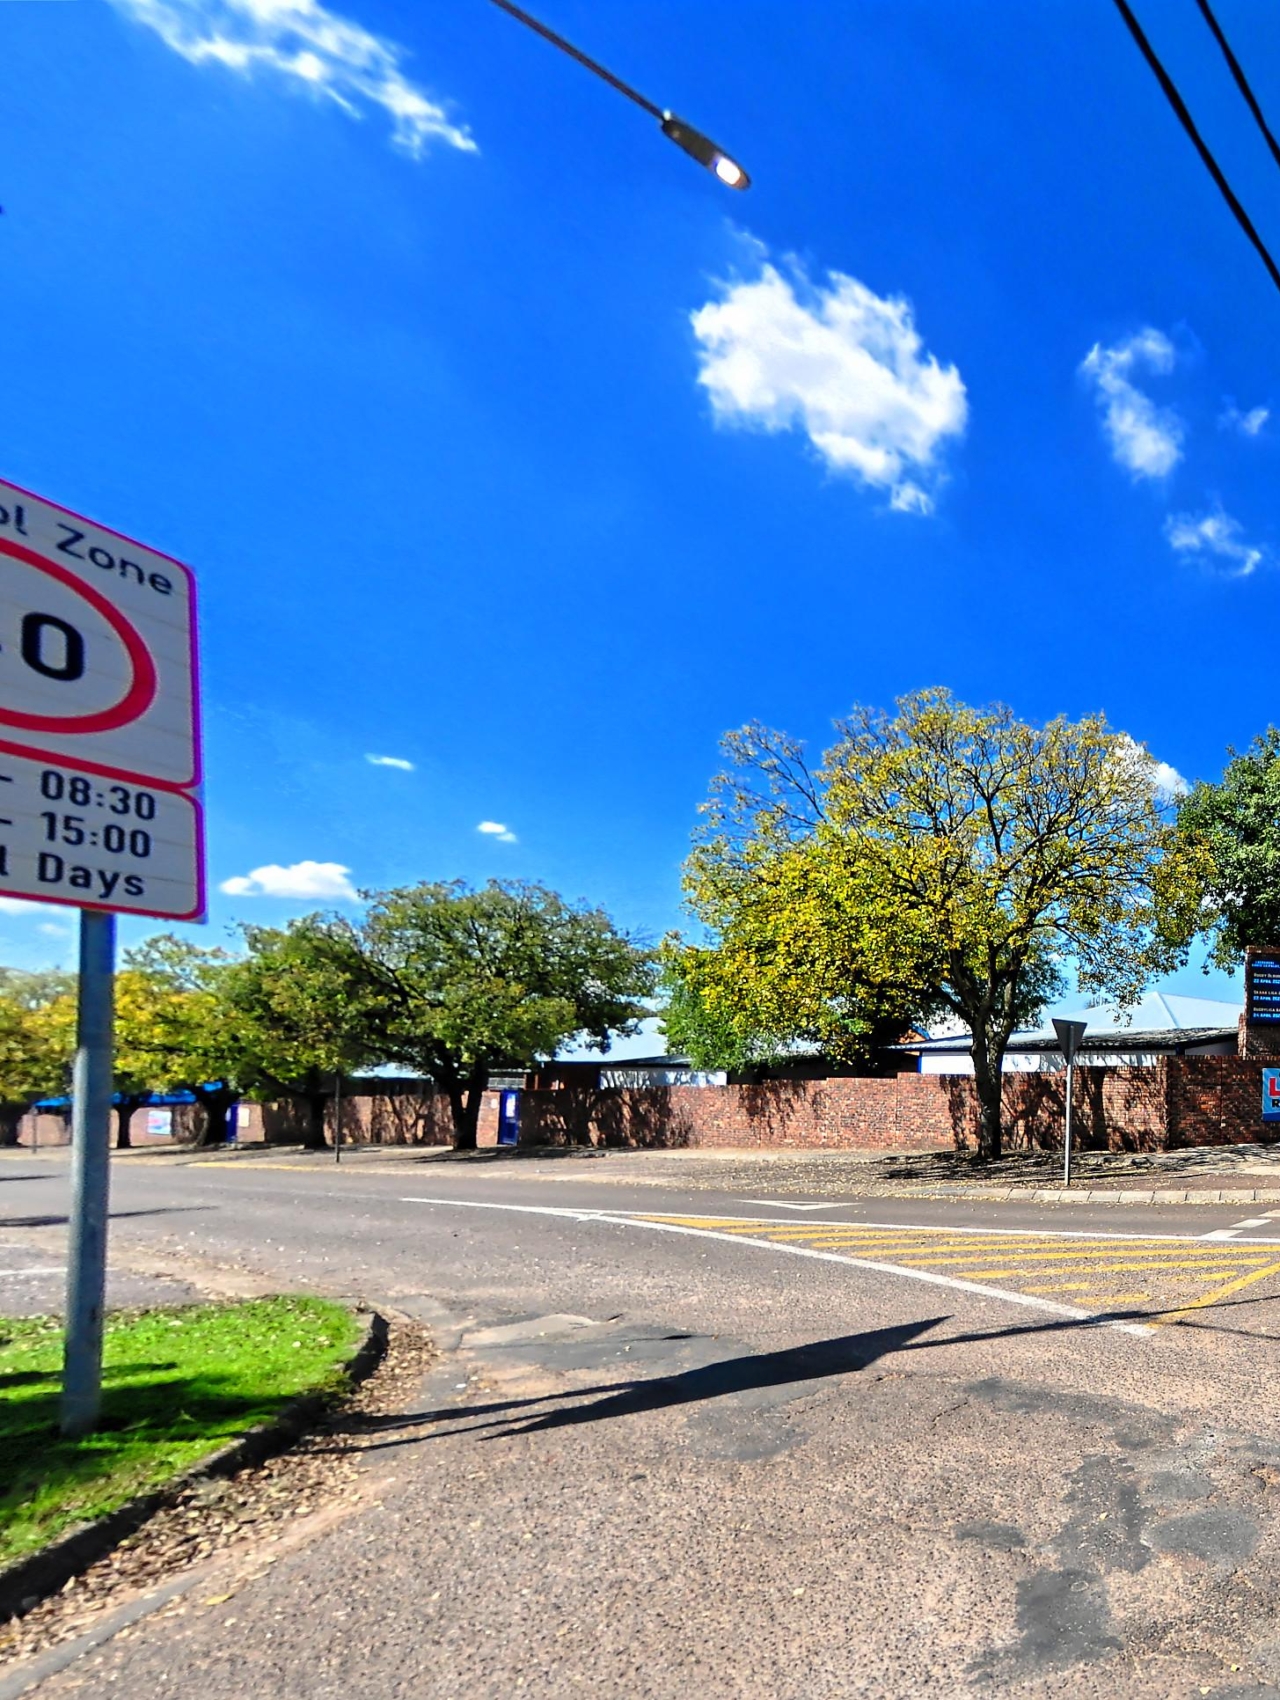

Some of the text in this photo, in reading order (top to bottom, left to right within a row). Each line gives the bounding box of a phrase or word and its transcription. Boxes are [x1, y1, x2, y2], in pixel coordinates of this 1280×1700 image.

[55, 522, 173, 595] Zone
[0, 611, 85, 682] 0
[40, 769, 156, 821] 08:30
[40, 811, 152, 858] 15:00
[37, 851, 145, 899] Days
